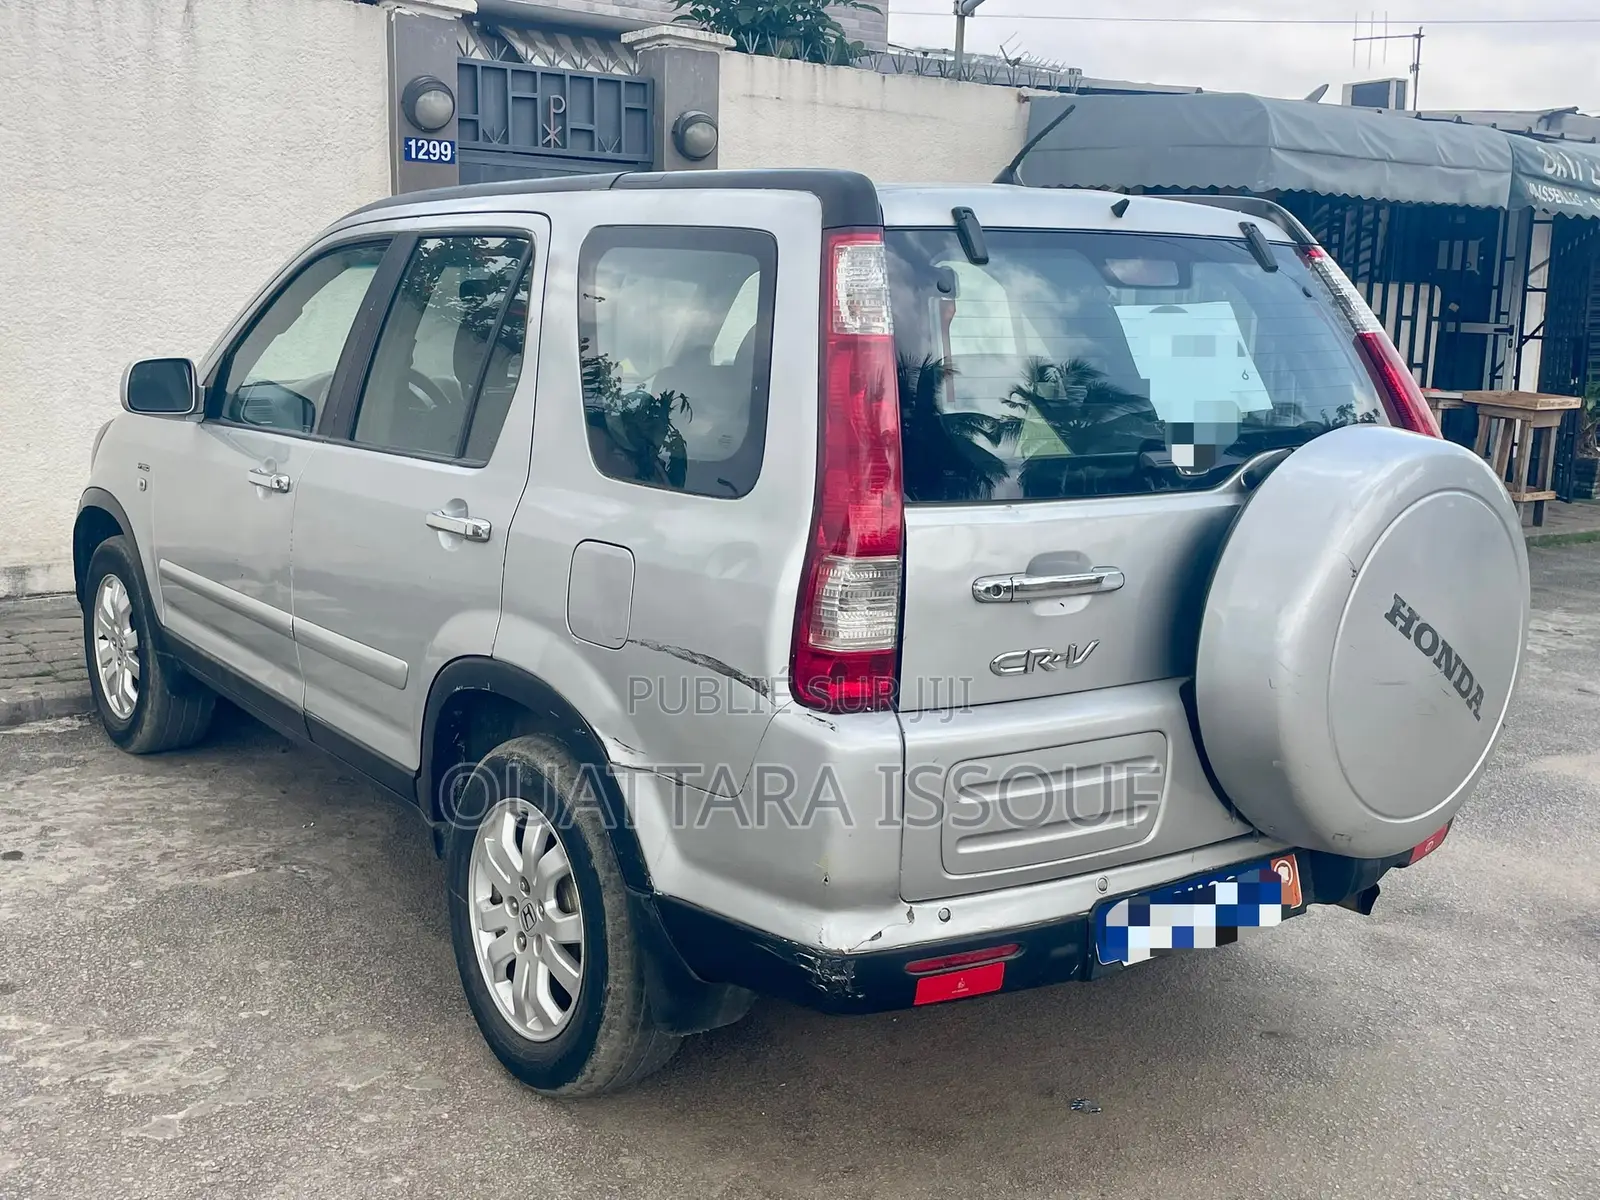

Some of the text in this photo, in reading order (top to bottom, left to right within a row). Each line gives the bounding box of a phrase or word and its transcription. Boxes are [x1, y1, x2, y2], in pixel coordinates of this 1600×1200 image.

[408, 138, 452, 163] 1299
[990, 639, 1100, 677] CR-V
[1384, 593, 1484, 722] HONDA
